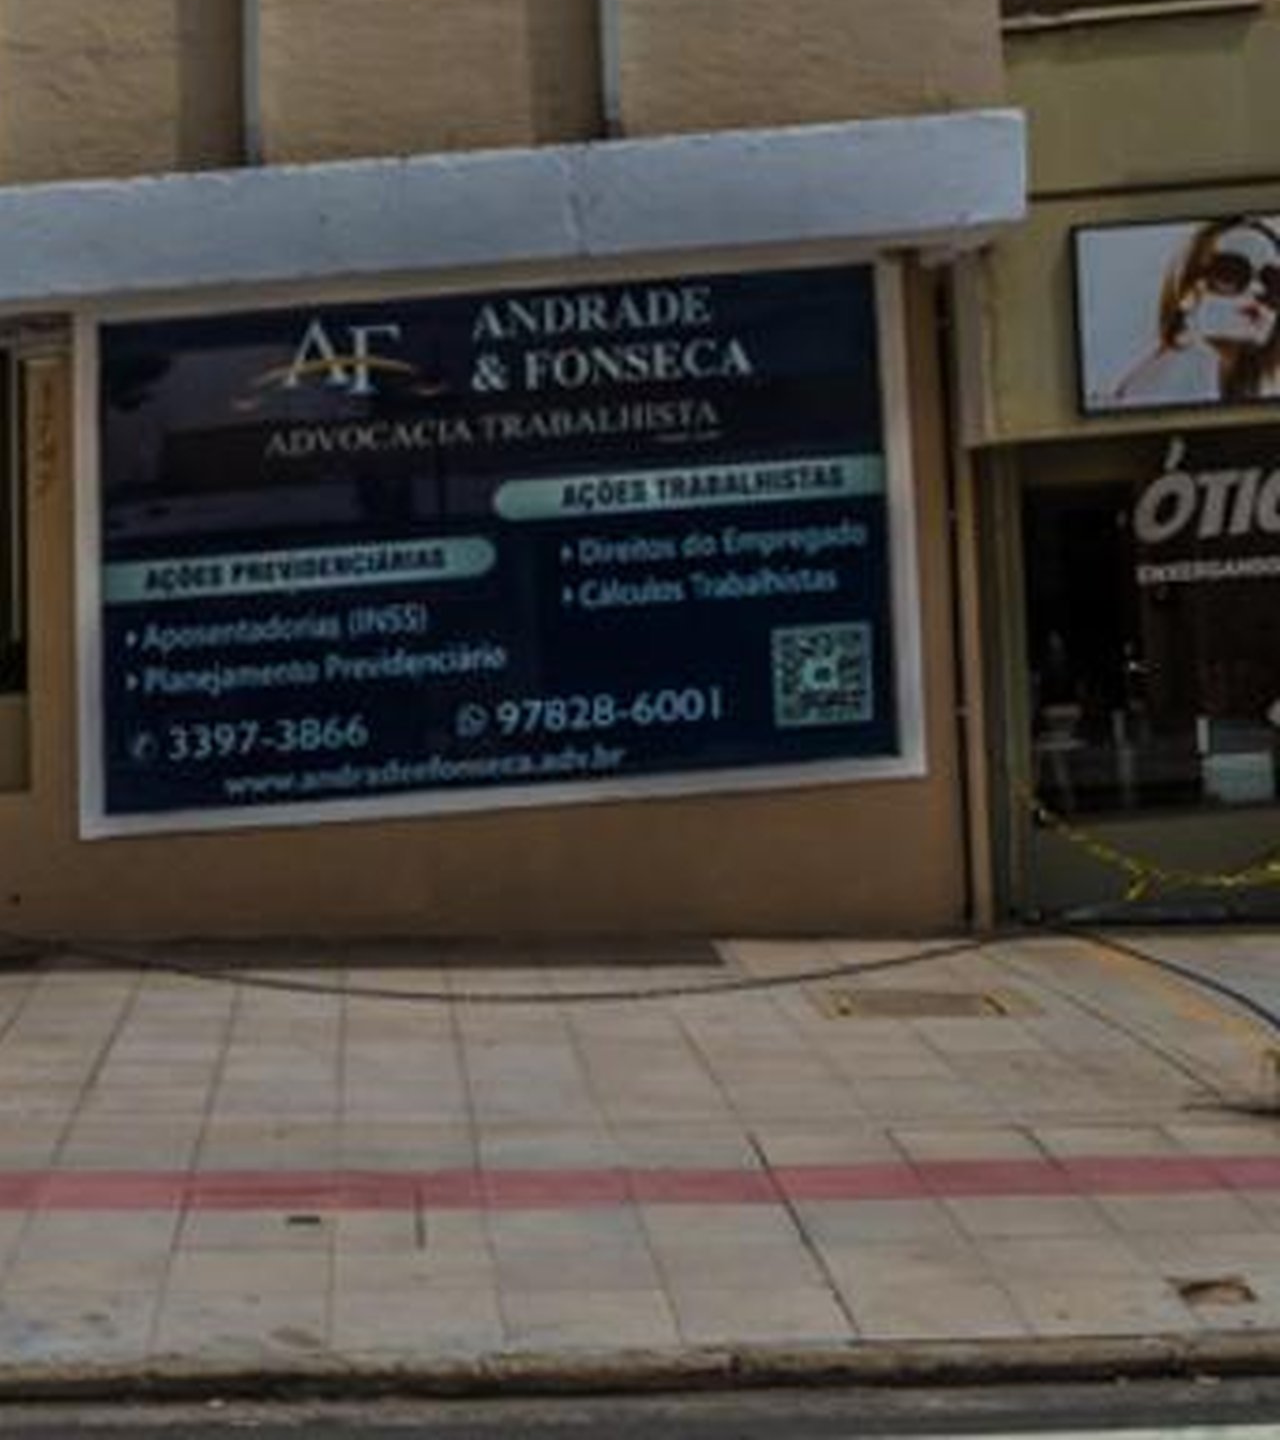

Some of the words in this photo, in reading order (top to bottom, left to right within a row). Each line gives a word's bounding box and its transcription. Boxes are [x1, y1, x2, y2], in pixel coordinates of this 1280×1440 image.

[471, 284, 713, 342] ANDRADE
[471, 354, 507, 392] &
[523, 337, 755, 390] FONSECA
[264, 418, 473, 458] ADVOCACIA
[477, 399, 721, 443] TRABALHISTA
[561, 480, 648, 511] AÇÕES
[656, 464, 843, 501] TRABALHISTAS
[578, 536, 678, 565] Direitos
[680, 530, 717, 557] do
[726, 519, 867, 556] Empregado
[145, 565, 223, 598] AÇÕES
[229, 547, 442, 585] PREVIDENCIÁRIAS
[578, 577, 686, 609] Cálculos
[690, 566, 838, 601] Trabalhistas
[142, 614, 338, 655] Aposentadorias
[347, 601, 428, 636] (INSS)
[143, 657, 319, 697] Planejamento
[324, 642, 508, 682] Previdenciário
[495, 687, 721, 738] 97828-6001
[168, 713, 369, 764] 3397-3866
